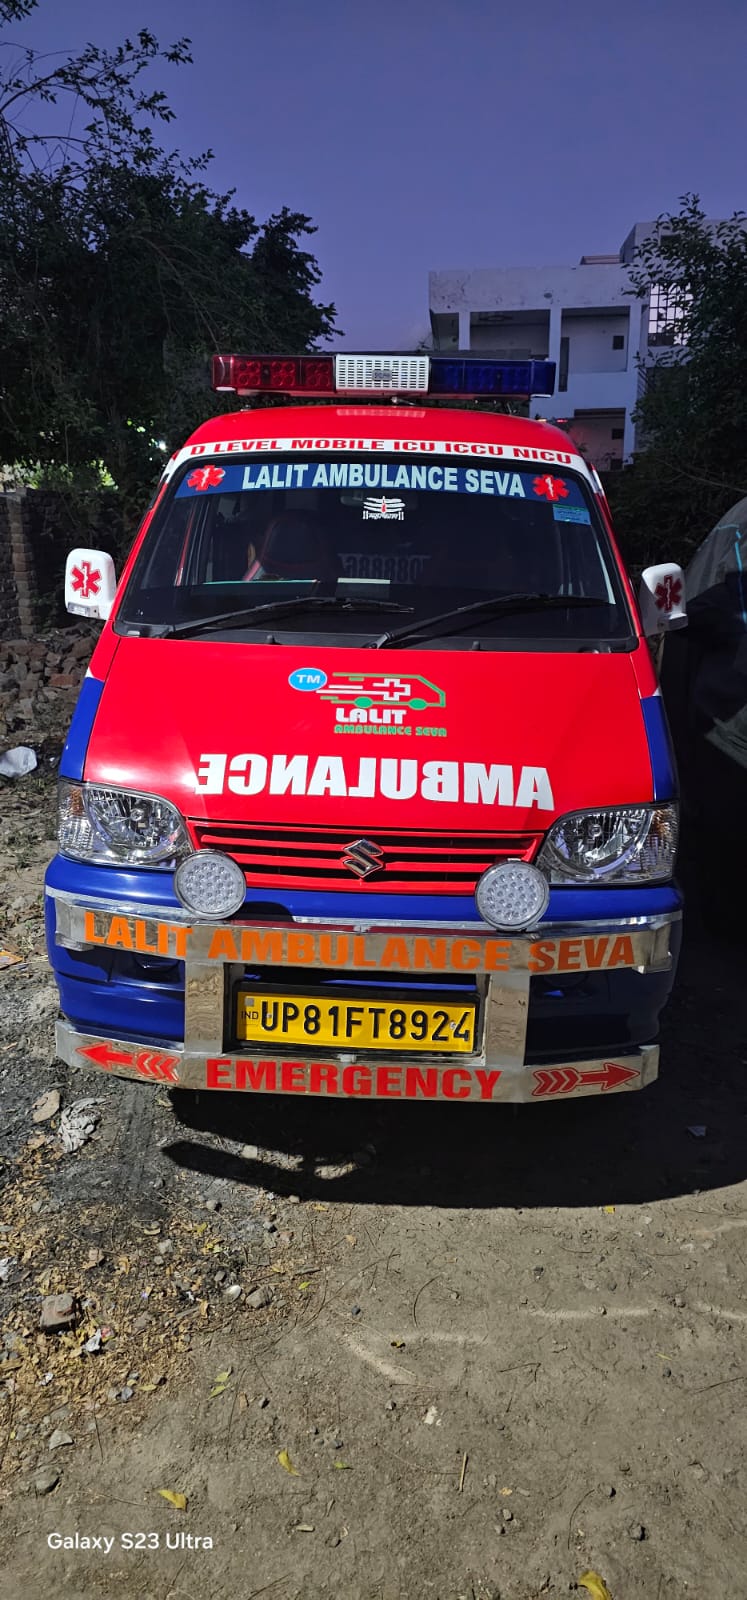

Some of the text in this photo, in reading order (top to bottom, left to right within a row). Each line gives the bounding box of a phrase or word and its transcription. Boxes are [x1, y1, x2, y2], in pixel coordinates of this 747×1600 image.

[190, 439, 571, 464] D LEVEL MOBILE ICU ICCU NICU
[242, 463, 526, 498] LALIT AMBULANCE SEVA
[296, 674, 321, 684] TM
[333, 724, 448, 737] AMBULANCE SEVA
[335, 707, 407, 724] LALIT
[84, 912, 636, 973] LALIT AMBULANCE SEVA
[241, 1000, 472, 1042] IND UP81FT8924
[206, 1058, 505, 1100] EMERGENCY
